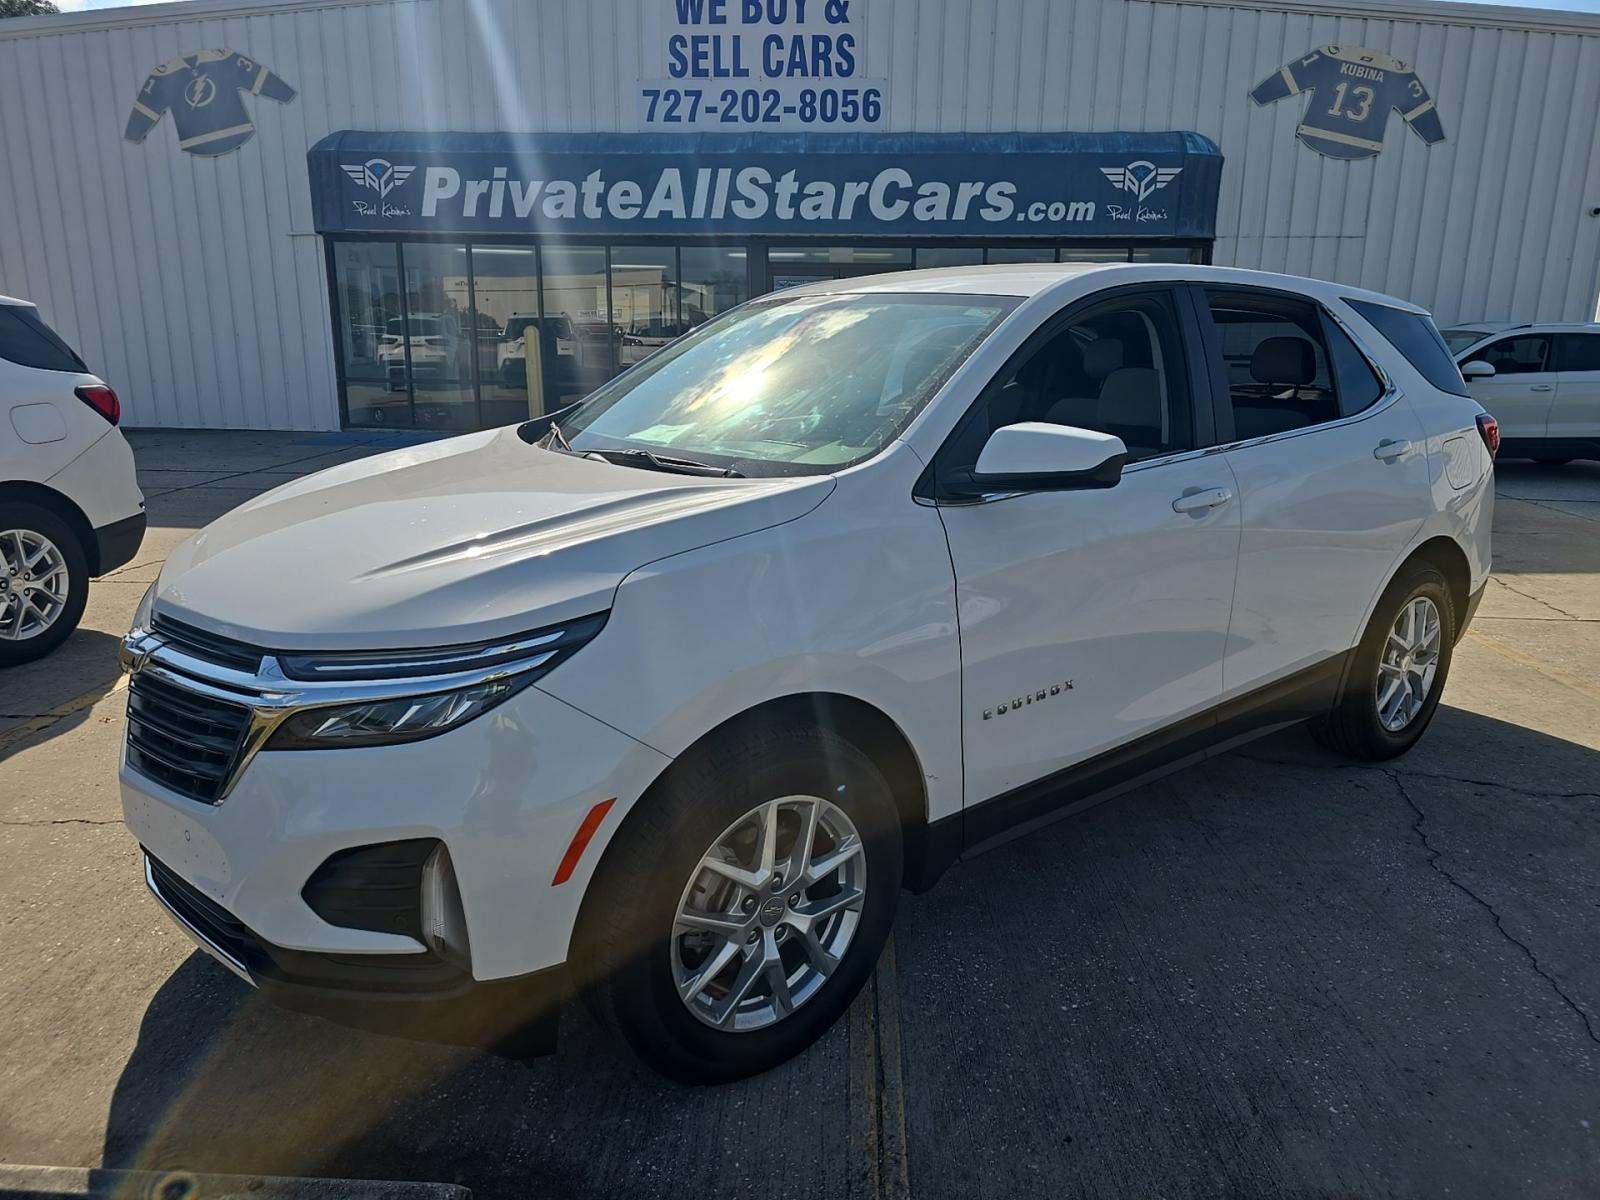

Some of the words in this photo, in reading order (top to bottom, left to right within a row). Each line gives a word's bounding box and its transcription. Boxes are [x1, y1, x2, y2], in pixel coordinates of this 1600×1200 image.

[675, 0, 727, 25] WE
[741, 0, 810, 25] BUY
[824, 0, 850, 25] &
[668, 35, 750, 78] SELL
[762, 33, 856, 78] CARS
[1340, 62, 1384, 83] KUBINA
[642, 88, 882, 124] 727-202-8056
[1328, 82, 1375, 122] 13
[421, 166, 1096, 223] PrivateAllStarCars.com
[983, 680, 1074, 720] EQUINOX
